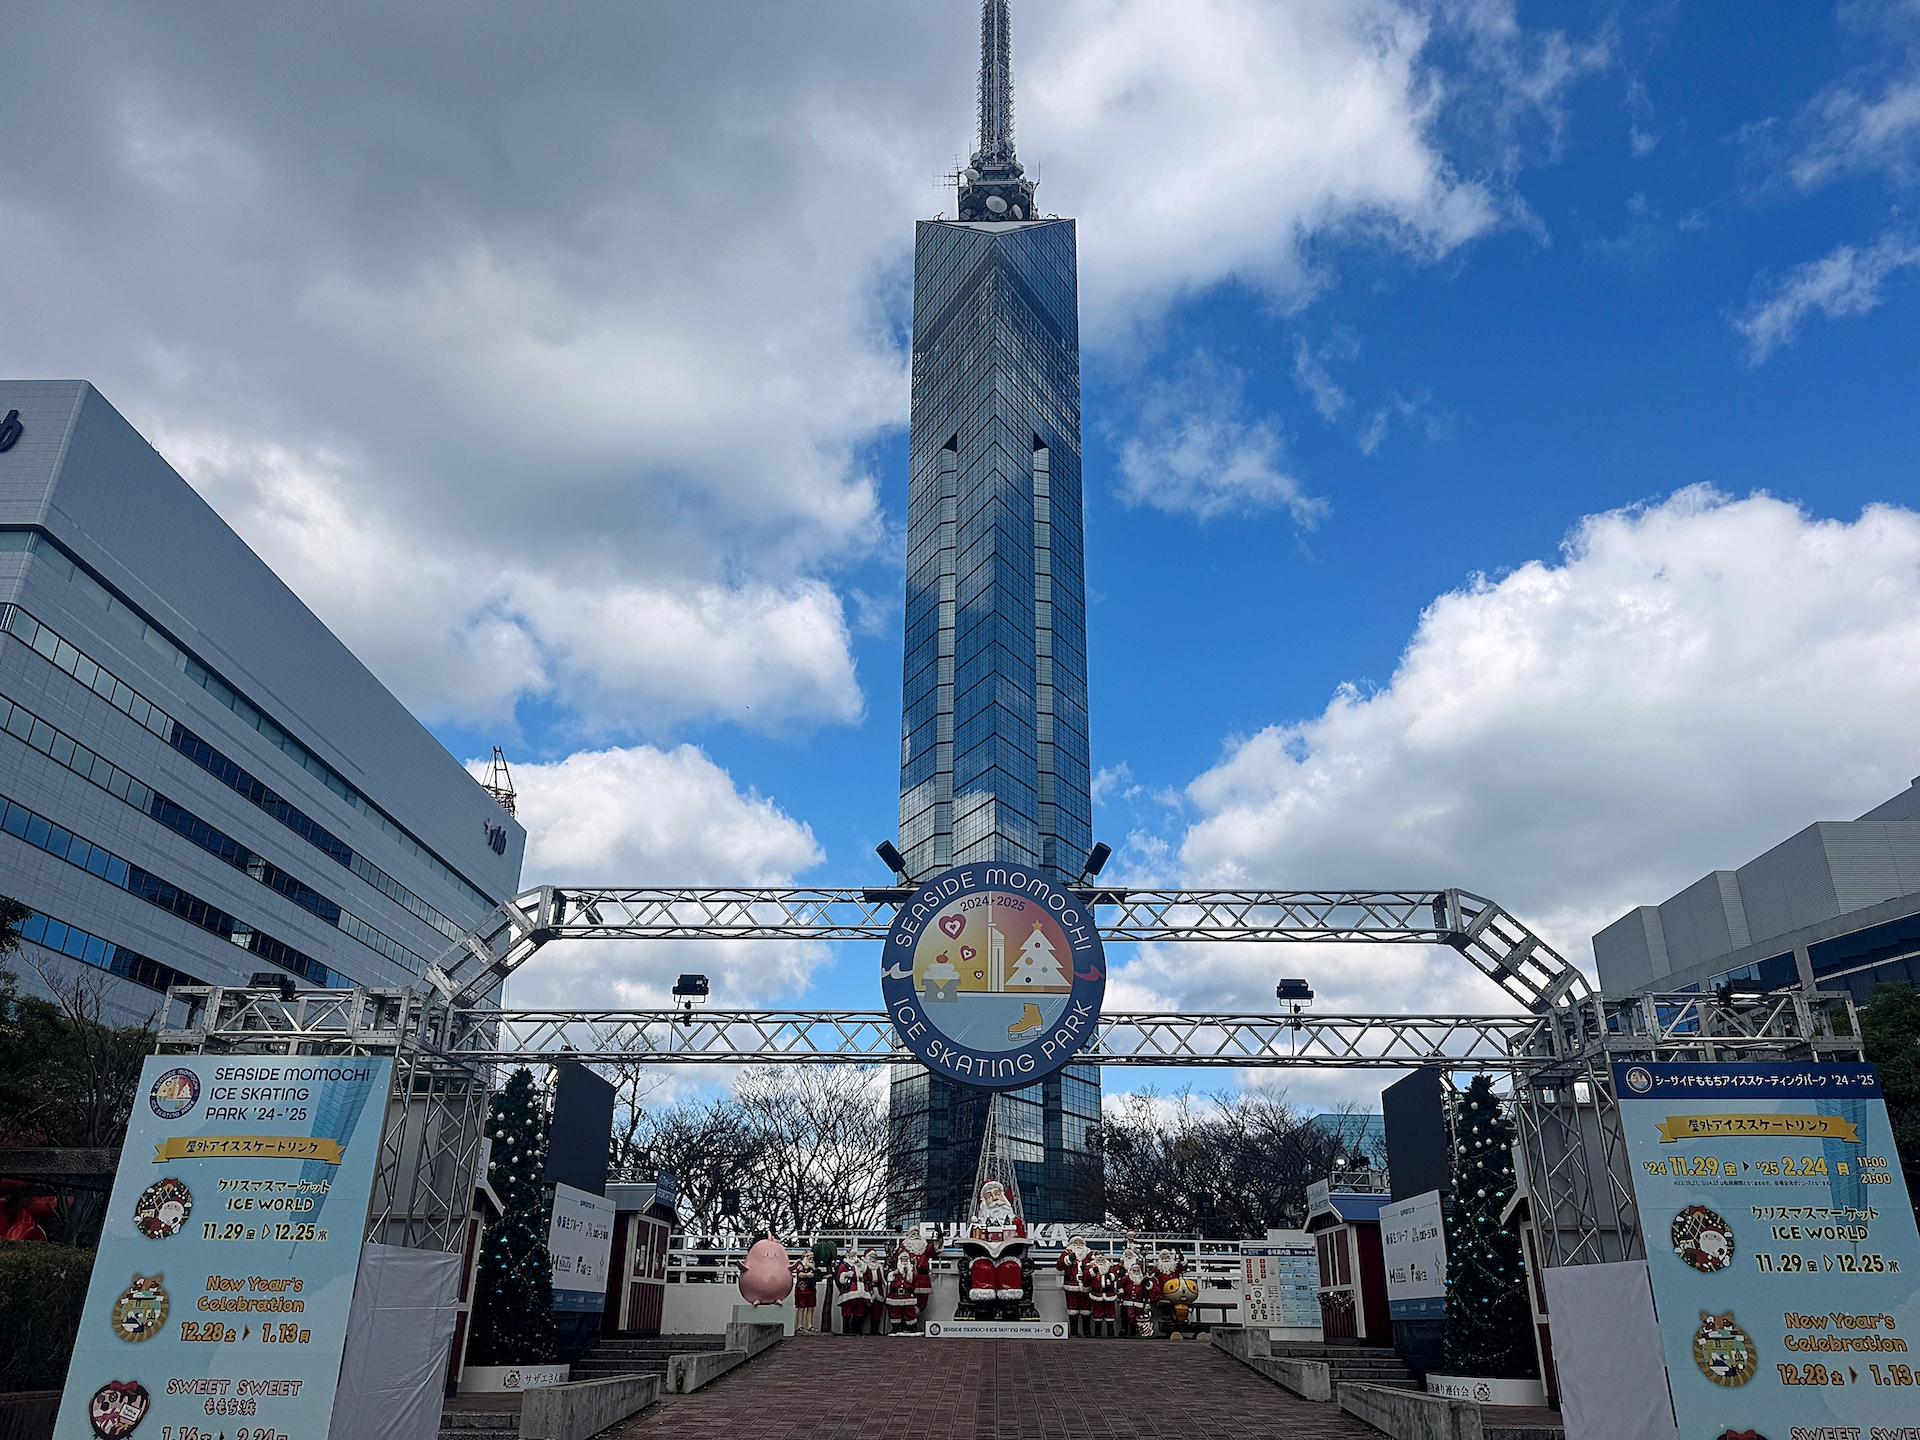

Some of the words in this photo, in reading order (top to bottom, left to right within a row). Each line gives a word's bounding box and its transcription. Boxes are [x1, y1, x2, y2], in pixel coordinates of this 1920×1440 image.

[896, 871, 976, 948] SEASIDE
[986, 869, 1092, 951] MOMOCHI
[960, 896, 989, 912] 2024
[997, 896, 1026, 912] 2025
[893, 998, 927, 1041] ICE
[927, 1040, 1035, 1078] SKATING
[1041, 1000, 1093, 1060] PARK
[214, 1067, 280, 1081] SEASIDE
[283, 1067, 370, 1082] MOMOCHI
[1655, 1074, 1826, 1087] シーサイドももちアイススケーティングパーク
[209, 1087, 236, 1100] ICE
[241, 1087, 310, 1101] SKATING
[205, 1107, 246, 1120] PARK
[1688, 1118, 1828, 1132] 屋外アイススケートリンク
[186, 1140, 318, 1153] 屋外アイススケートリンク
[1643, 1161, 1667, 1176] '24
[1668, 1156, 1719, 1177] 11.29
[1723, 1161, 1737, 1177] 金
[1756, 1161, 1779, 1176] '25
[1781, 1156, 1828, 1177] 2.24
[1837, 1161, 1850, 1176] 月
[1857, 1156, 1887, 1169] 11:00
[218, 1179, 330, 1194] クリスマスマーケット
[1860, 1172, 1891, 1185] 21:00
[227, 1198, 254, 1210] ICE
[258, 1198, 313, 1211] WORLD
[1751, 1206, 1879, 1220] クリスマスマーケット
[203, 1223, 244, 1240] 11.29
[275, 1223, 315, 1240] 12.25
[919, 1222, 1069, 1247] FUKA
[1772, 1226, 1802, 1240] ICE
[1805, 1226, 1868, 1240] WORLD
[1755, 1254, 1802, 1272] 11.29
[1836, 1254, 1884, 1272] 12.25
[206, 1276, 246, 1292] New
[248, 1276, 304, 1292] Year's
[197, 1296, 305, 1313] Celebration
[1784, 1312, 1828, 1330] New
[1829, 1312, 1896, 1330] Year's
[180, 1322, 225, 1342] 12.28
[262, 1323, 298, 1343] 1.13
[1784, 1334, 1908, 1352] Celebration
[1777, 1363, 1829, 1386] 12.28
[1869, 1363, 1914, 1386] 1.13
[167, 1378, 231, 1395] SWEET
[237, 1380, 303, 1396] SWEET
[204, 1397, 257, 1416] ももち浜
[162, 1426, 200, 1440] 116
[237, 1428, 276, 1440] 224
[1790, 1427, 1861, 1440] SWEET
